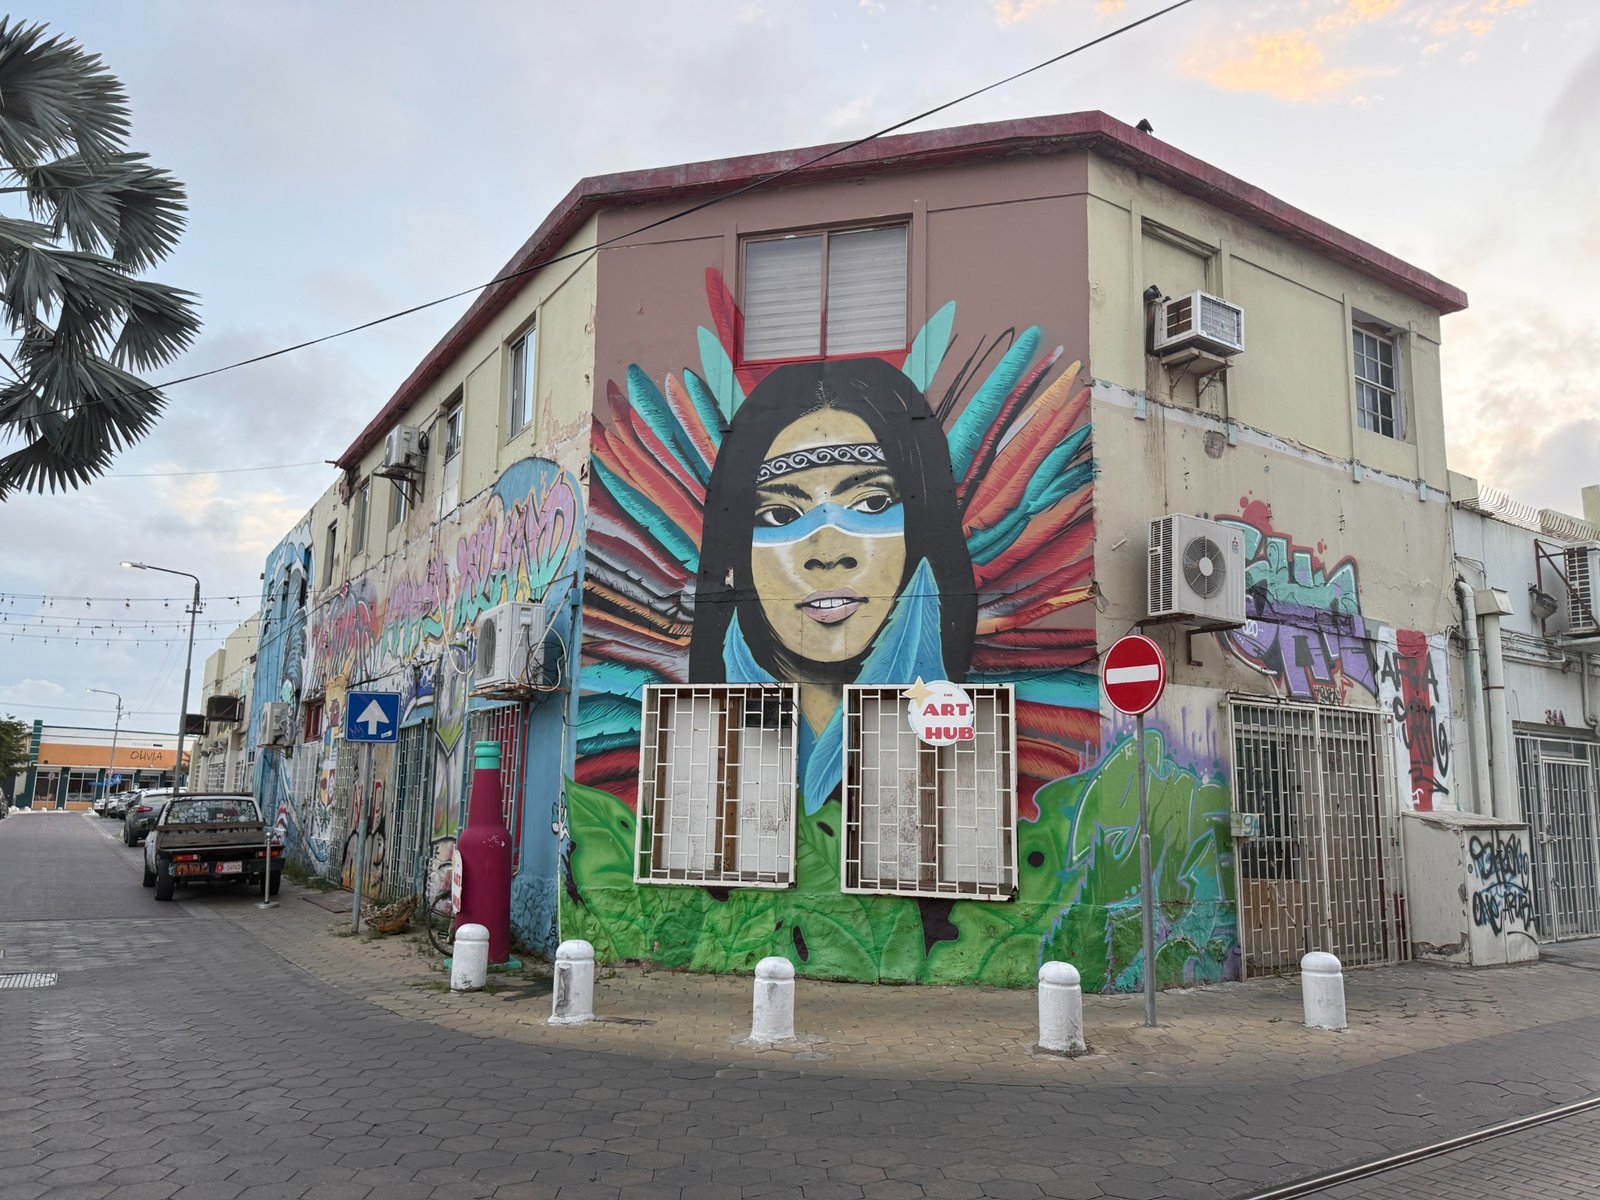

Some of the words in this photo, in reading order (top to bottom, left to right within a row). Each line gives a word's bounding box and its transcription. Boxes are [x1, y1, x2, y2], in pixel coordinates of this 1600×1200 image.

[922, 703, 970, 717] ART
[925, 726, 975, 740] HUB
[130, 750, 163, 761] OLIVIA
